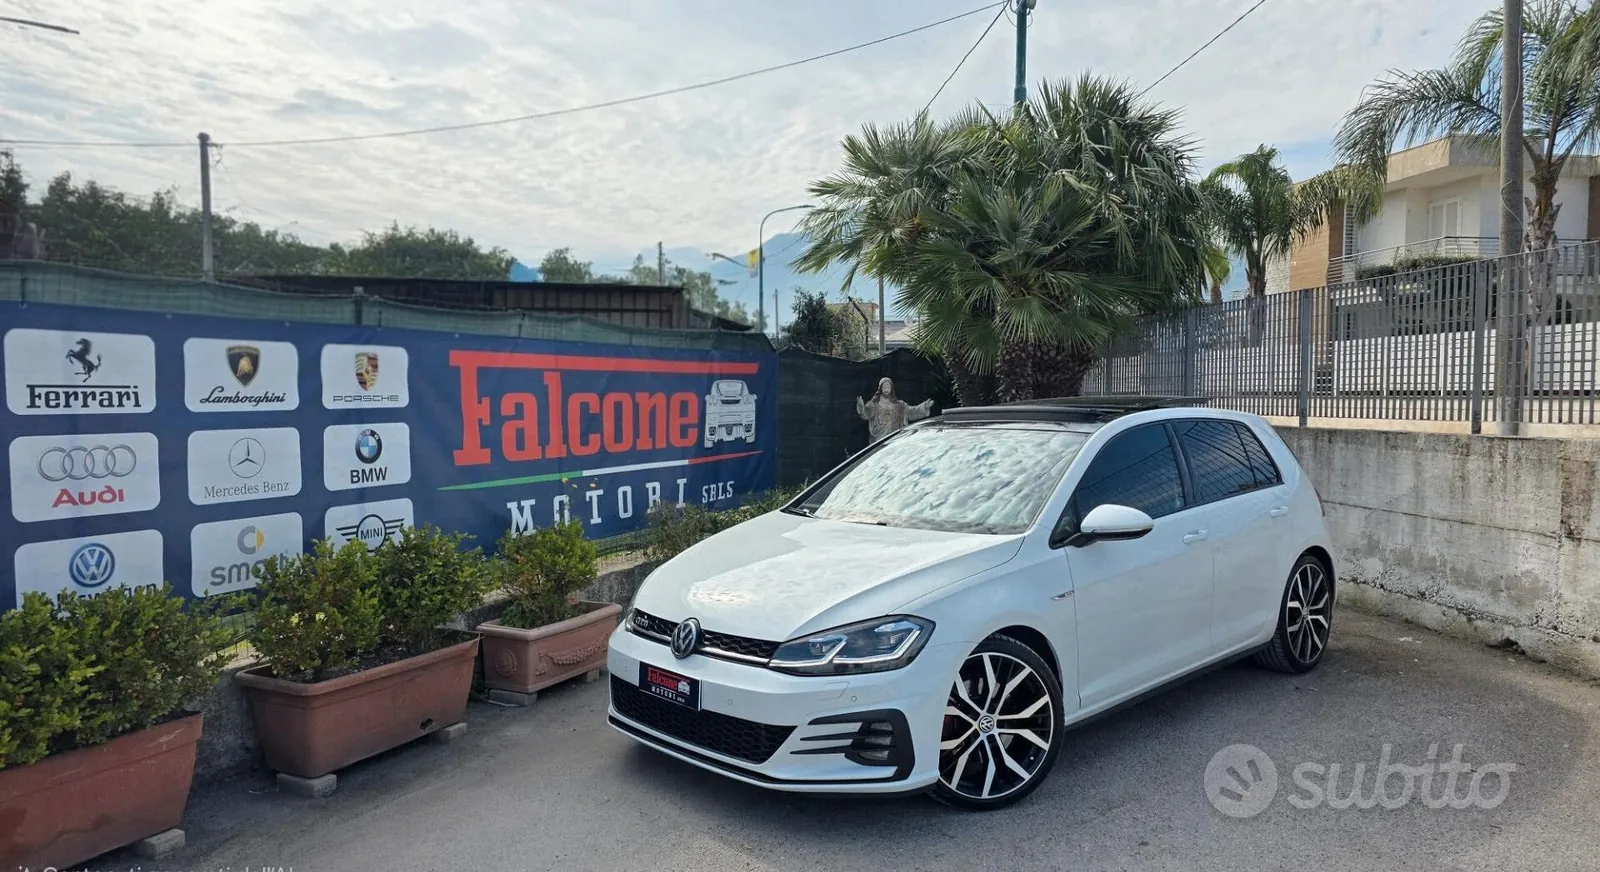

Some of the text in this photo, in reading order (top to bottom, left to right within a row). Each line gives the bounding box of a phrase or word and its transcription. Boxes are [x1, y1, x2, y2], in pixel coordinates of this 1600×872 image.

[26, 384, 141, 409] Ferrari
[200, 385, 286, 407] Lamborghini
[333, 394, 399, 403] PORSCHE
[449, 350, 758, 466] Falcone
[350, 467, 388, 484] BMW
[52, 485, 125, 508] Audi
[204, 481, 290, 499] Mercedes Benz
[507, 478, 735, 538] MOTORI SRLS
[360, 527, 383, 540] MINI
